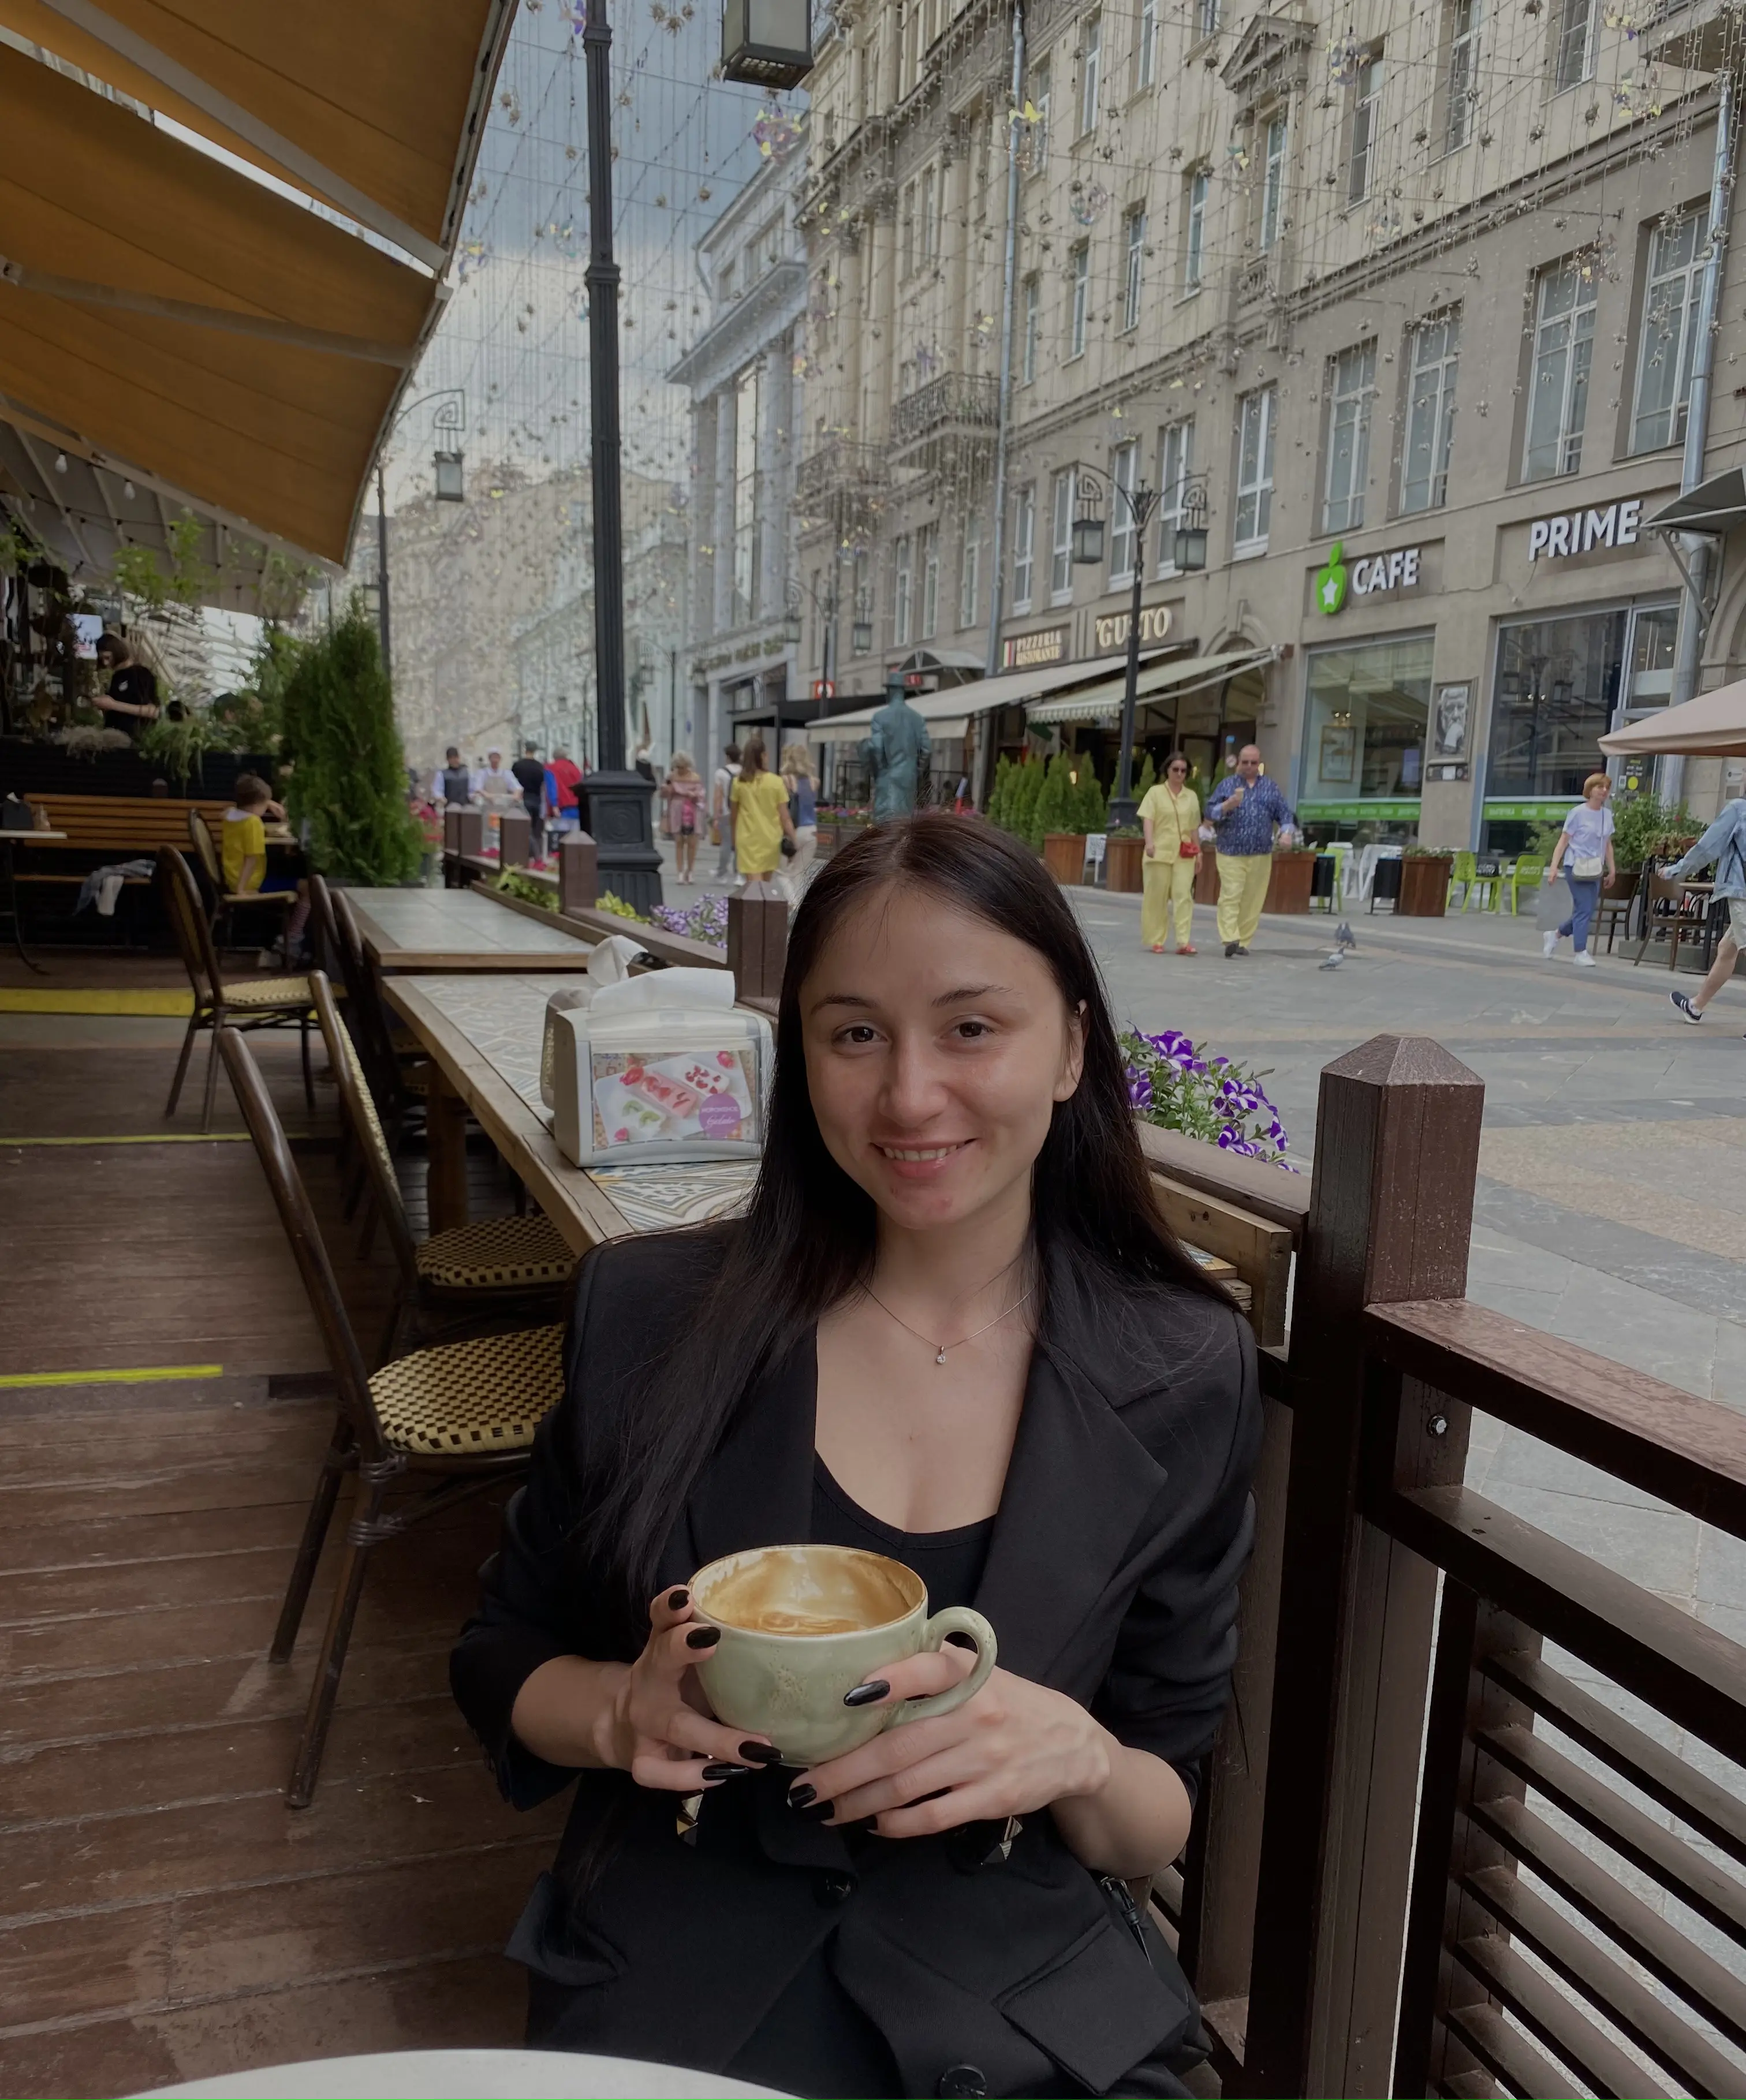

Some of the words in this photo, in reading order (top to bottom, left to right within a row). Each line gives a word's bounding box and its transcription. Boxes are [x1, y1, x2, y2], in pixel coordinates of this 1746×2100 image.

[1529, 500, 1640, 562] PRIME
[1352, 549, 1419, 595] CAFE
[1016, 630, 1062, 653] PIZZERIA
[1096, 607, 1172, 648] 'GUTO
